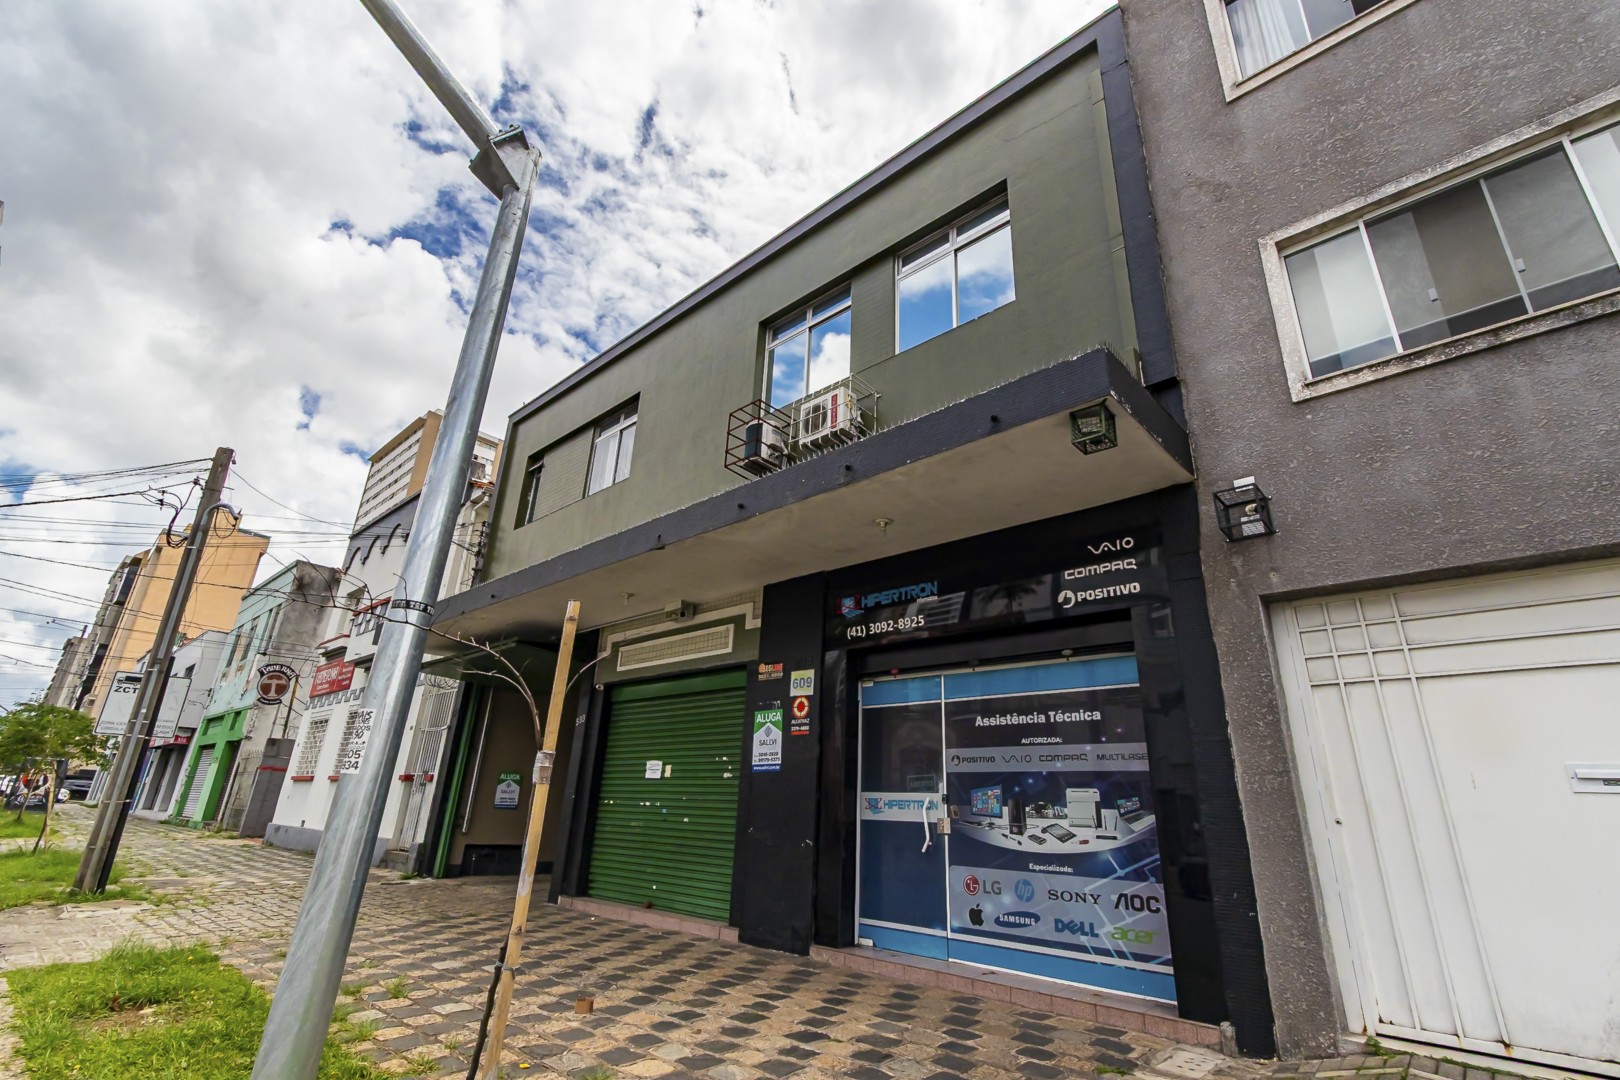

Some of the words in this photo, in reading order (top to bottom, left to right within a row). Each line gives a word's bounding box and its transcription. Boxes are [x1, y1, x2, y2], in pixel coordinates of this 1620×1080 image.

[1087, 537, 1134, 554] VAIO
[1065, 559, 1138, 580] COMPAQ
[861, 581, 938, 609] HIPERTRON
[1077, 582, 1141, 602] POSITIVO
[847, 624, 866, 639] (41)
[869, 615, 925, 635] 3092-8925
[114, 686, 139, 694] ZCT
[792, 676, 812, 689] 609
[756, 711, 781, 723] ALUGA
[975, 711, 1045, 727] Assistência
[1048, 708, 1101, 723] Técnica
[1021, 736, 1062, 744] AUTORIZADA:
[961, 755, 996, 764] POSITIVO
[1001, 754, 1032, 764] VAIO
[1039, 753, 1088, 763] COMPAQ
[983, 879, 1002, 896] LG
[1017, 879, 1032, 902] hp
[1047, 889, 1102, 905] SONY
[1114, 893, 1160, 914] AOC
[999, 913, 1036, 926] SAMSUNG
[1054, 918, 1099, 938] DELL
[1111, 926, 1156, 944] acer
